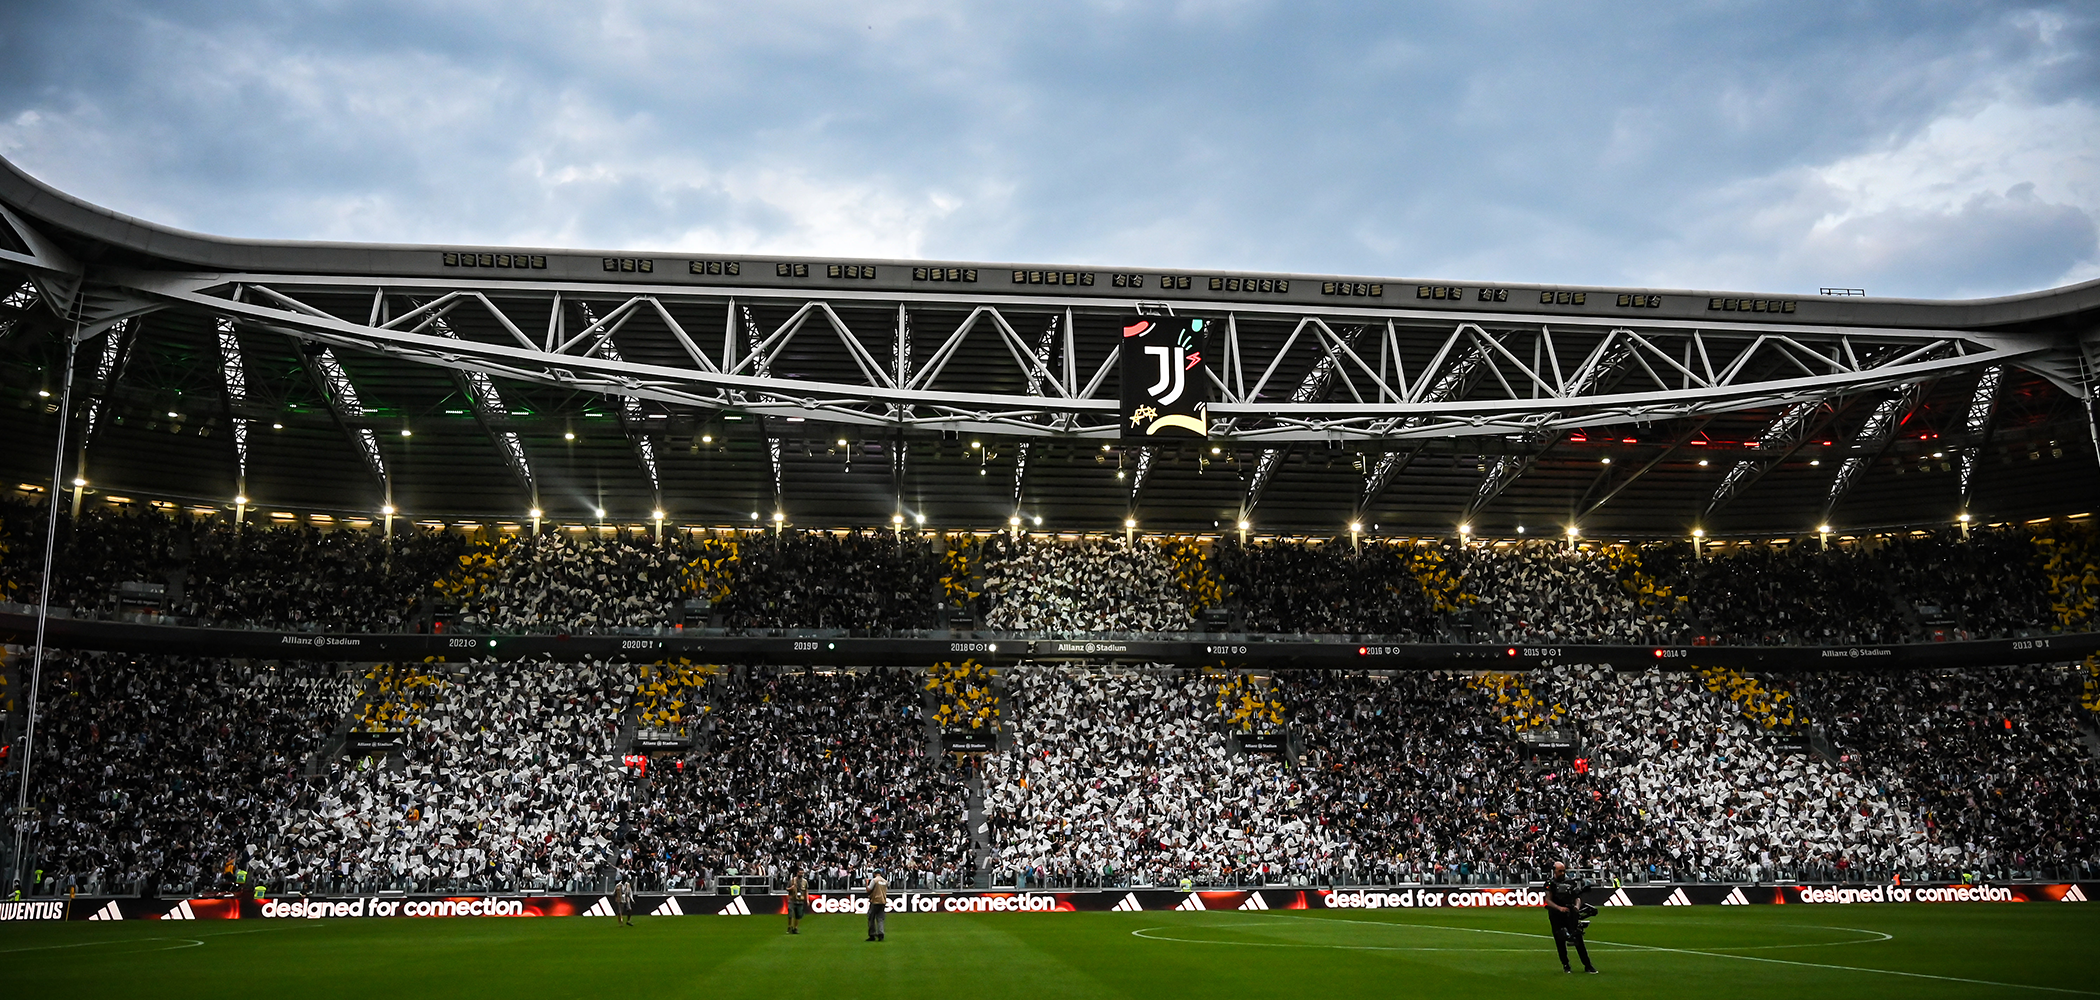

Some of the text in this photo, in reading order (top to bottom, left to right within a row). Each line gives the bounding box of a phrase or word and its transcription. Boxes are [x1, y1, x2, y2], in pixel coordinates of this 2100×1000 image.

[281, 636, 360, 645] Allianz Stadium
[449, 638, 467, 648] 2021
[622, 640, 640, 649] 2020
[794, 642, 812, 650] 2019
[950, 643, 968, 651] 2018
[1058, 643, 1126, 651] Allianz Stadium
[1213, 646, 1229, 654] 2017
[2012, 641, 2032, 650] 2013
[1366, 646, 1383, 655] 2016
[1523, 648, 1540, 657] 2015
[1662, 650, 1679, 658] 2014
[1822, 649, 1848, 657] Allianz
[1800, 884, 2011, 904] designed for connection
[811, 892, 1056, 914] desiged for connection
[1324, 889, 1413, 909] designed
[1416, 889, 1444, 907] for
[0, 902, 63, 920] UVENTUS
[261, 897, 523, 919] designed for connection
